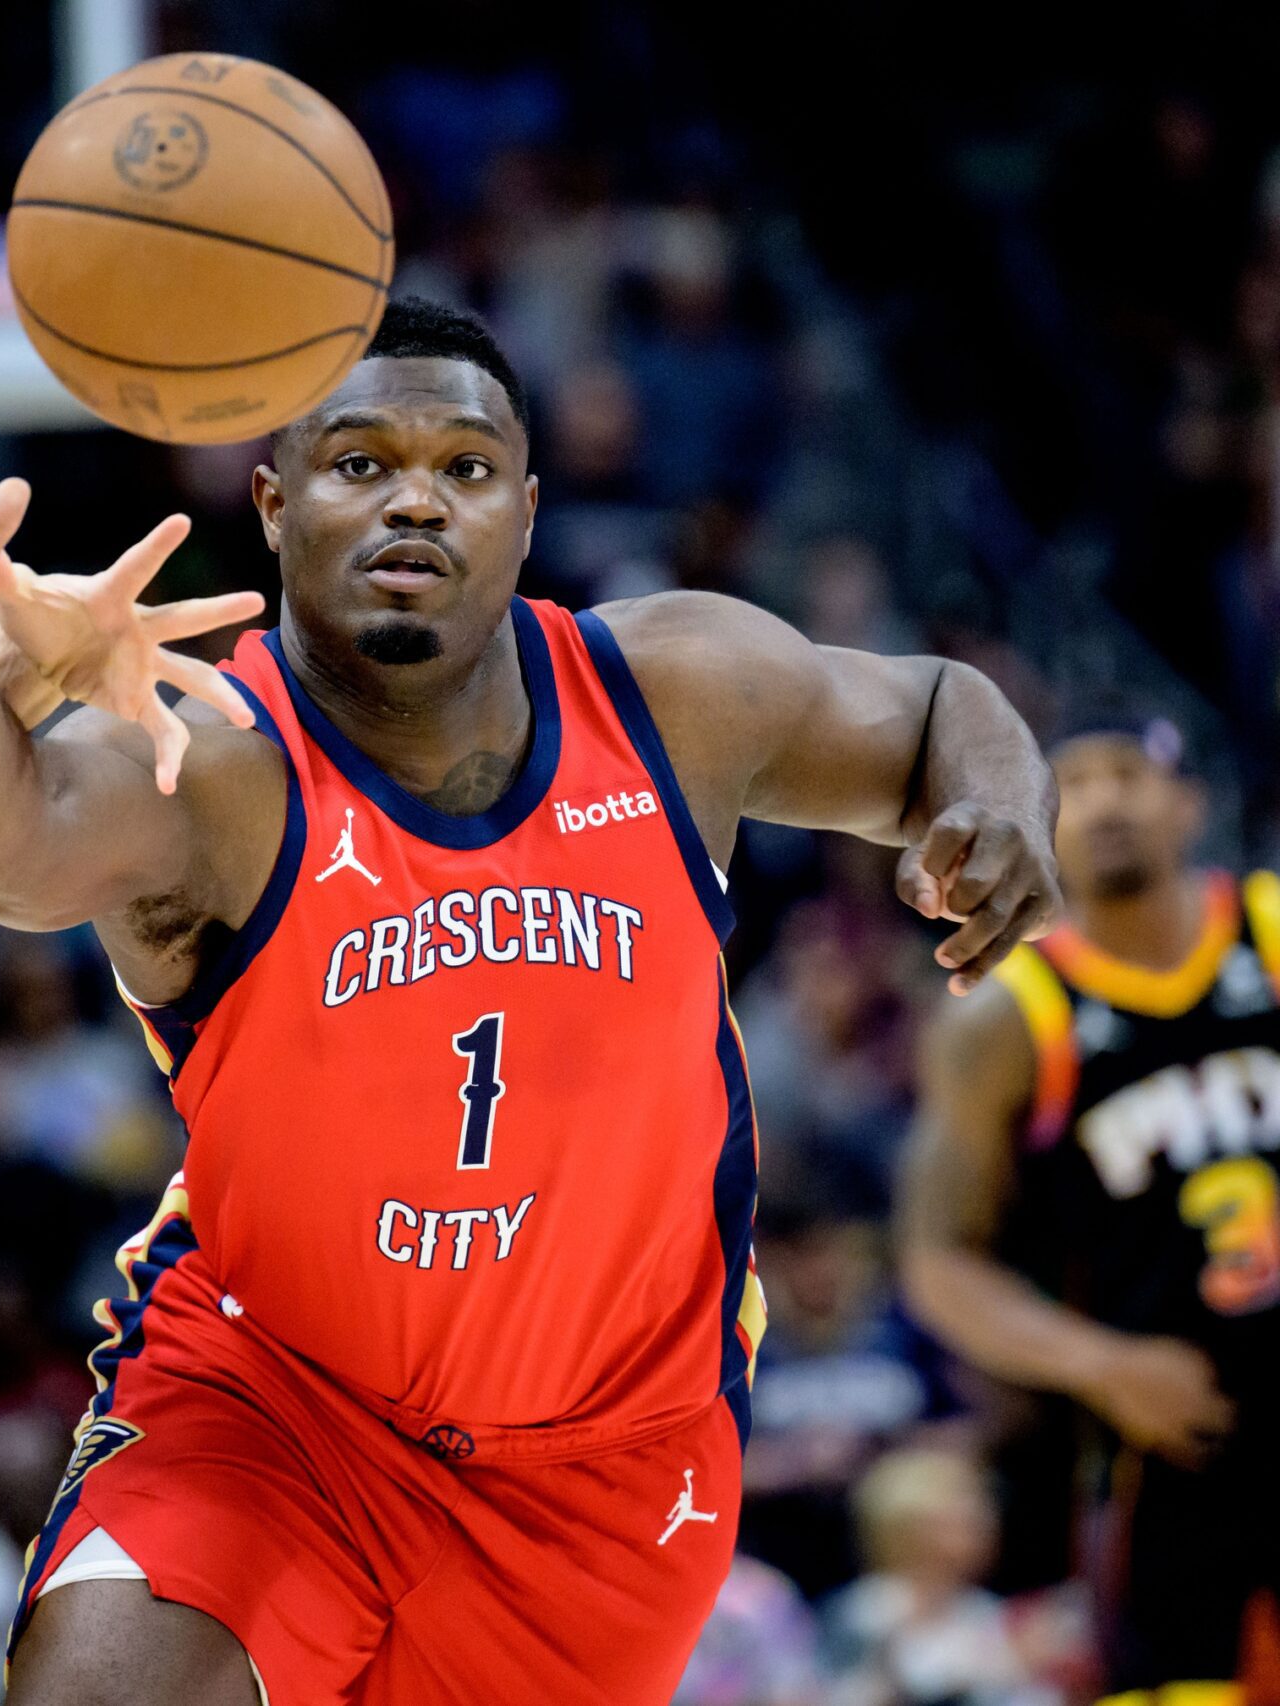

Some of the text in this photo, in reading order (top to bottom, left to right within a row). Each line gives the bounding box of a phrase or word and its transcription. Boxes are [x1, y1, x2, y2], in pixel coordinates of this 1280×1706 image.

[554, 789, 658, 834] ibotta
[323, 886, 643, 1008] CRESCENT
[451, 1011, 505, 1170] 1
[376, 1193, 537, 1271] CITY
[1178, 1156, 1278, 1315] 3
